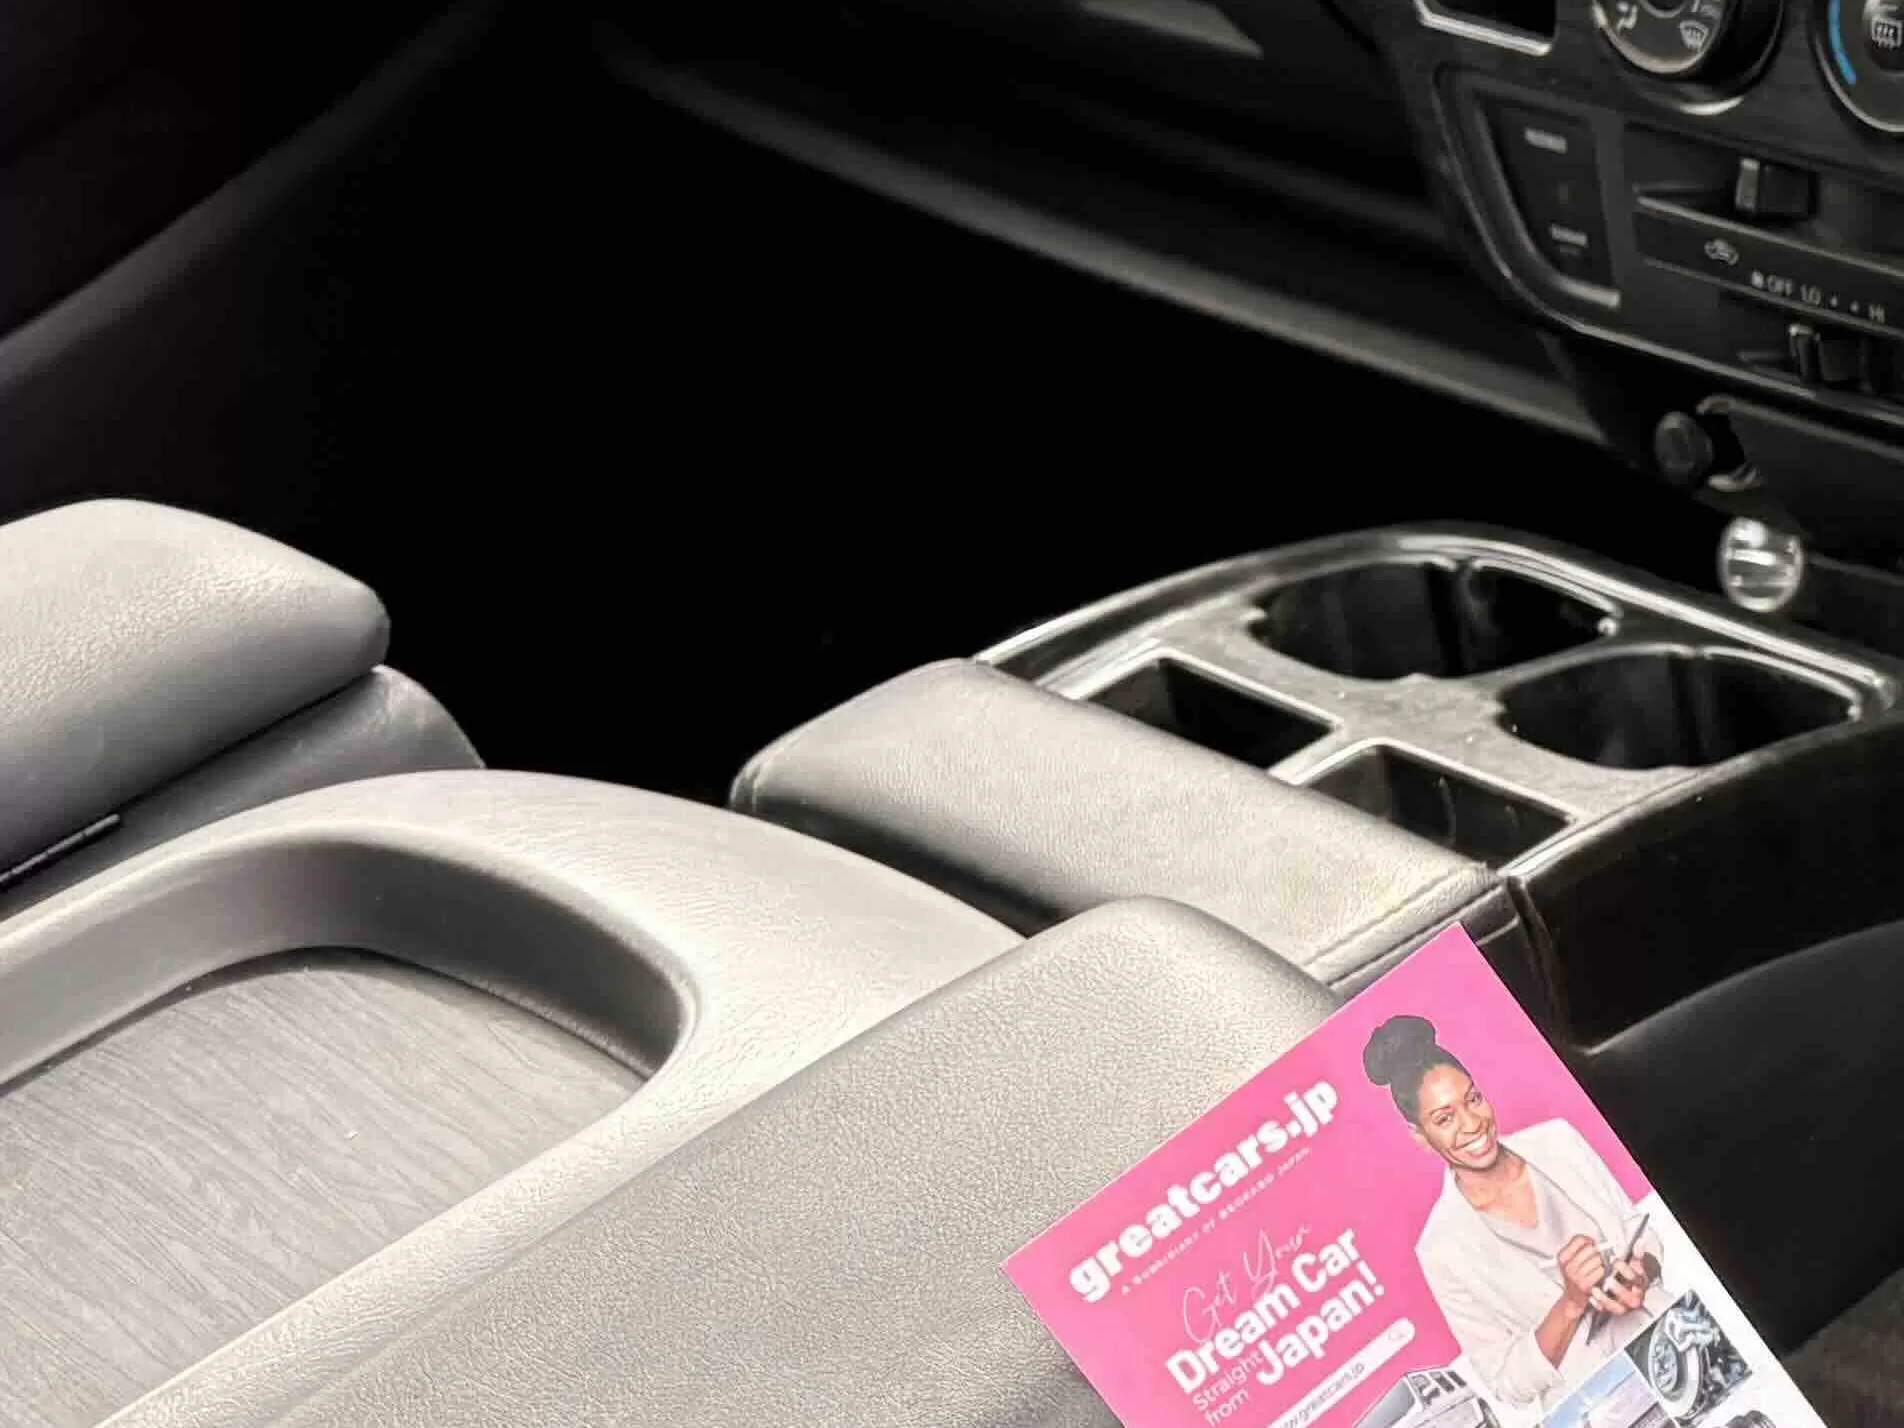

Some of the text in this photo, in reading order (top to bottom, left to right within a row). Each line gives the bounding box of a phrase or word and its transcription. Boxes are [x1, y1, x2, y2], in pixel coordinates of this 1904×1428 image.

[1069, 1081, 1337, 1302] greatcars.jp
[1165, 1228, 1359, 1394] Dream Car
[1182, 1268, 1246, 1346] Get
[1244, 1259, 1384, 1385] Japan!
[1191, 1350, 1263, 1414] Straight
[1204, 1388, 1249, 1427] from
